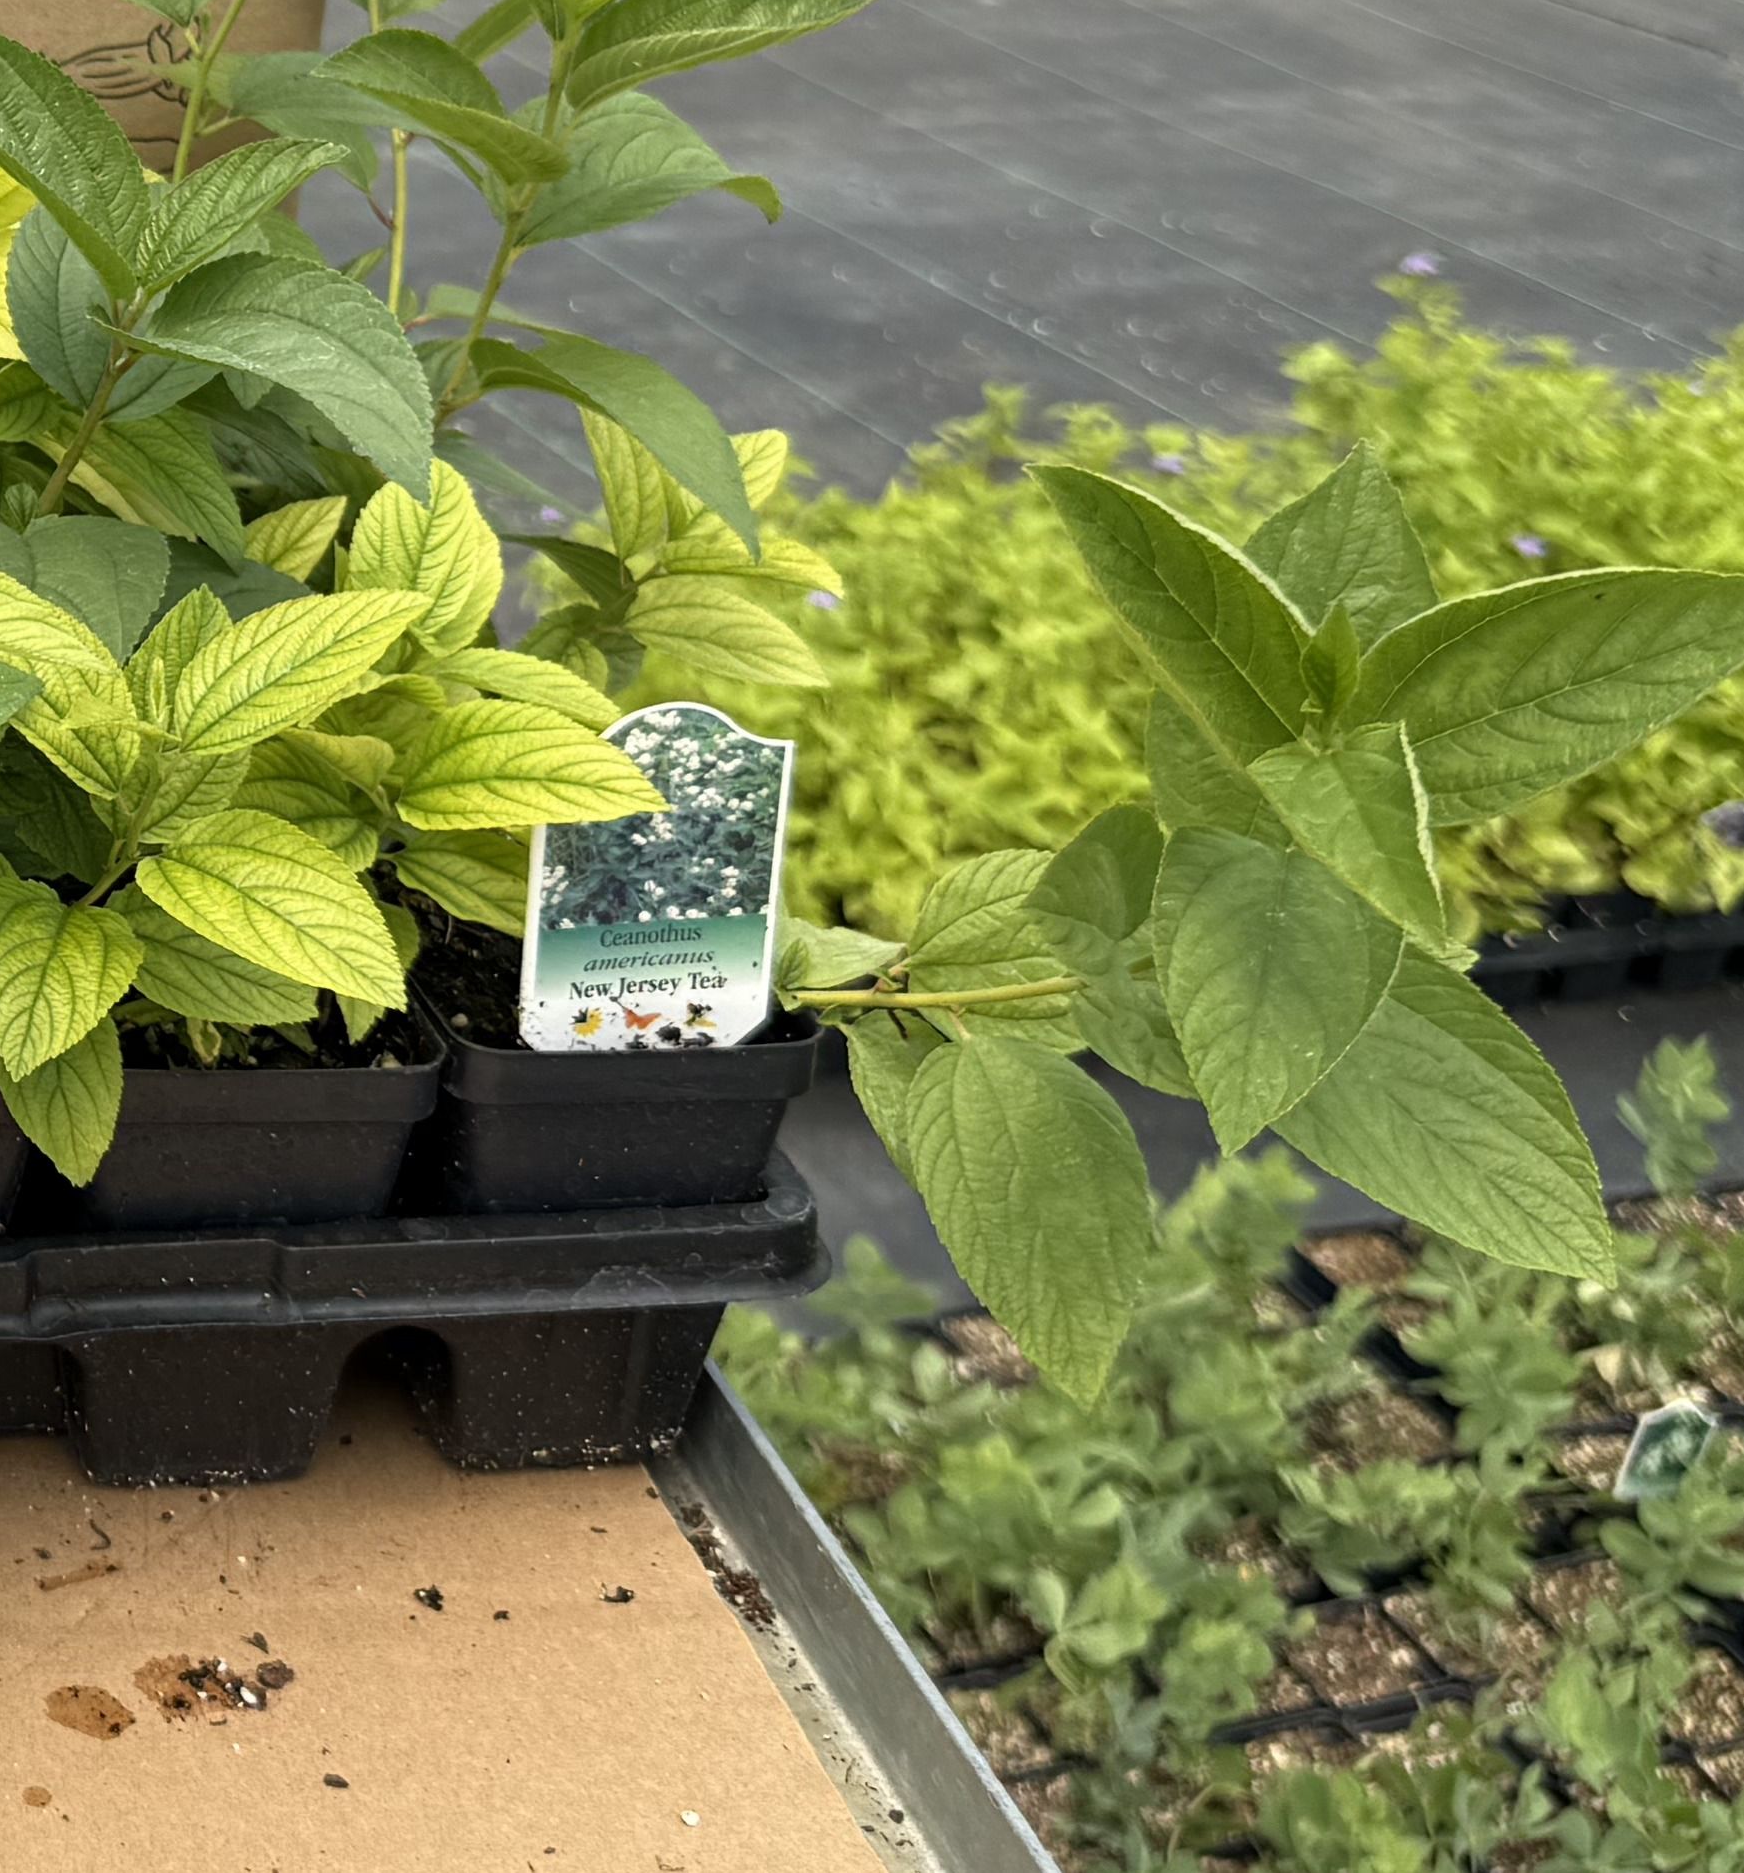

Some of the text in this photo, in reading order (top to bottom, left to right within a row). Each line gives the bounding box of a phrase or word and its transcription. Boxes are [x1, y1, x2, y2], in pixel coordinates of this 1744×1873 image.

[600, 924, 703, 948] Ceanothus
[583, 950, 715, 972] americanus
[569, 972, 724, 1001] New Jersey Tea
